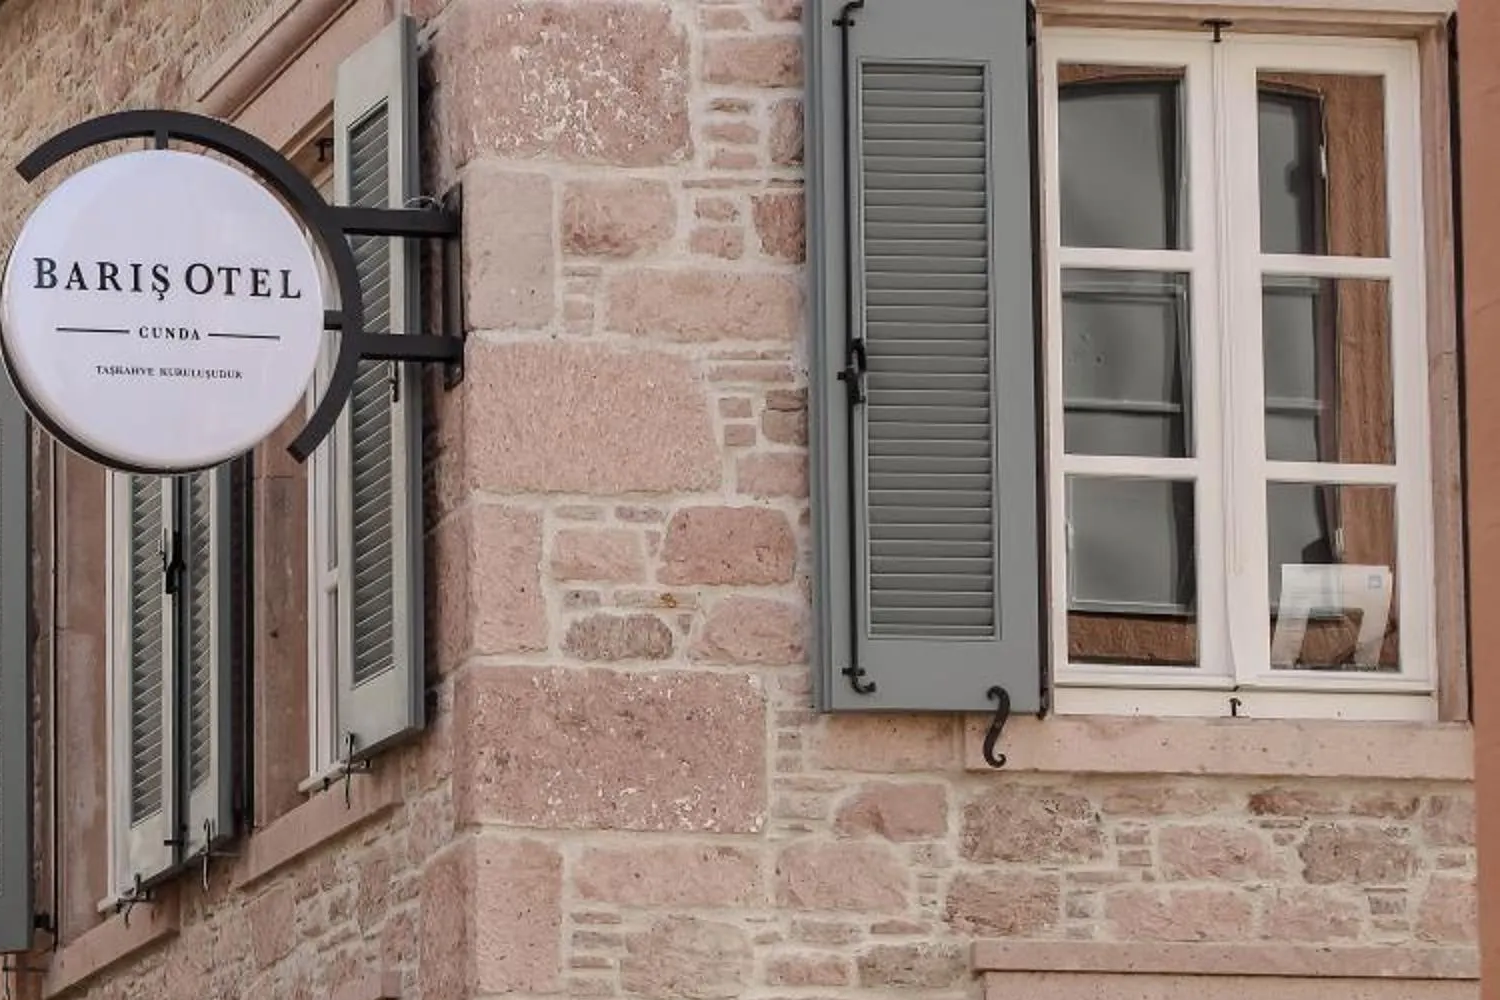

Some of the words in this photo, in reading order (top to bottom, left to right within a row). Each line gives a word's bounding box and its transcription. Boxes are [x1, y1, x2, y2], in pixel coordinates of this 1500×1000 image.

[33, 256, 170, 301] BARIŞ
[184, 262, 302, 299] OTEL
[138, 326, 201, 341] CUNDA
